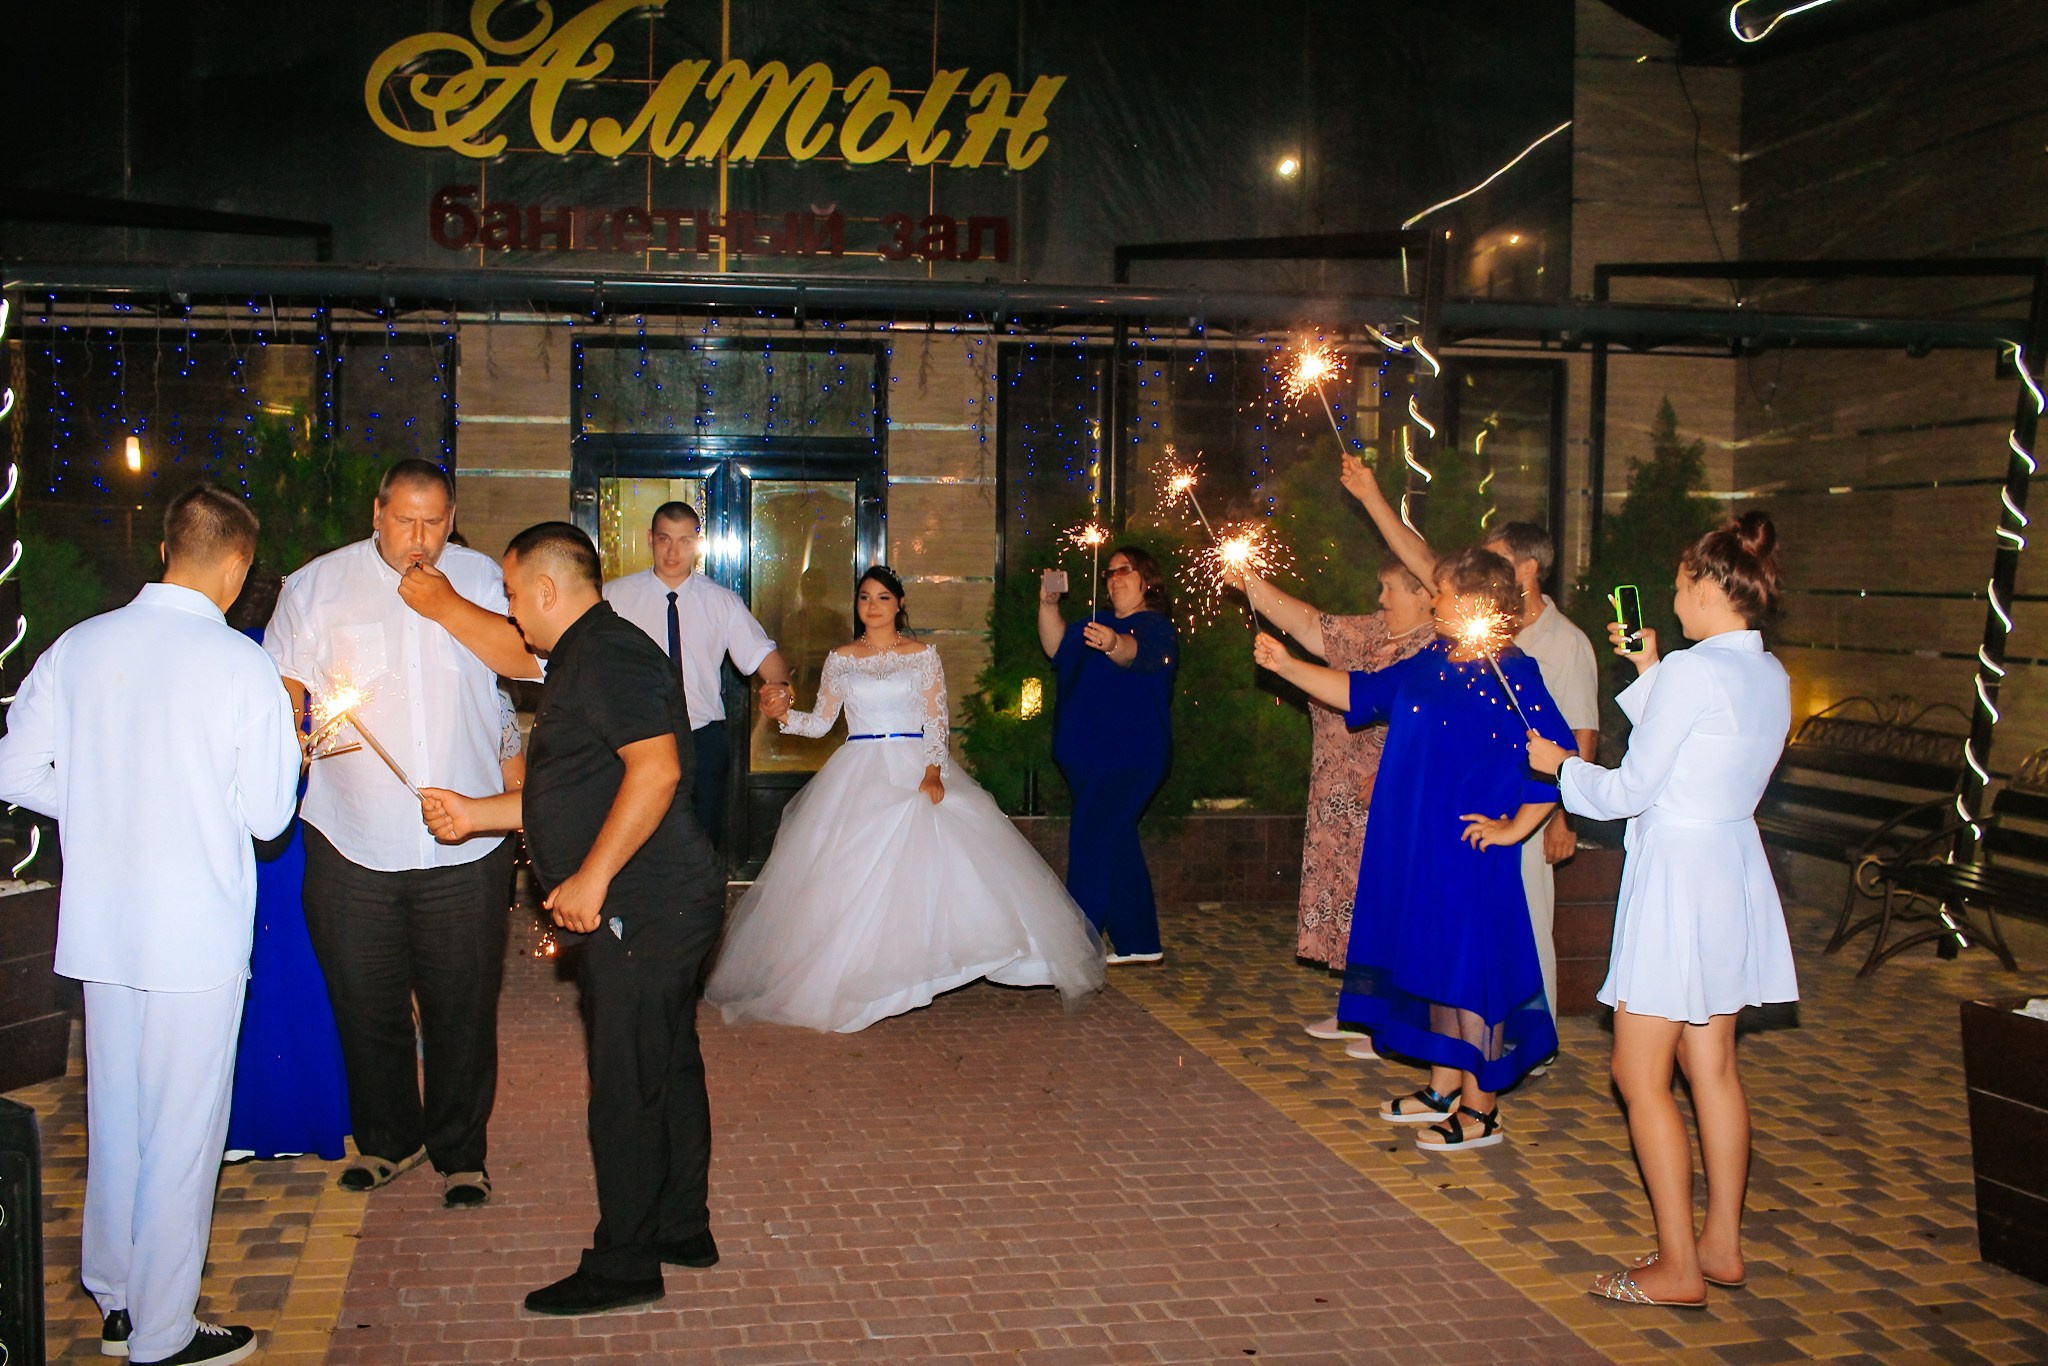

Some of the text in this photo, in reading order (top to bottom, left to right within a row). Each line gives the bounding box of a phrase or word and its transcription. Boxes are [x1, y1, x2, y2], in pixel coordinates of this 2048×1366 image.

[365, 0, 1067, 171] Алтын
[430, 184, 1009, 263] банкетный зал
